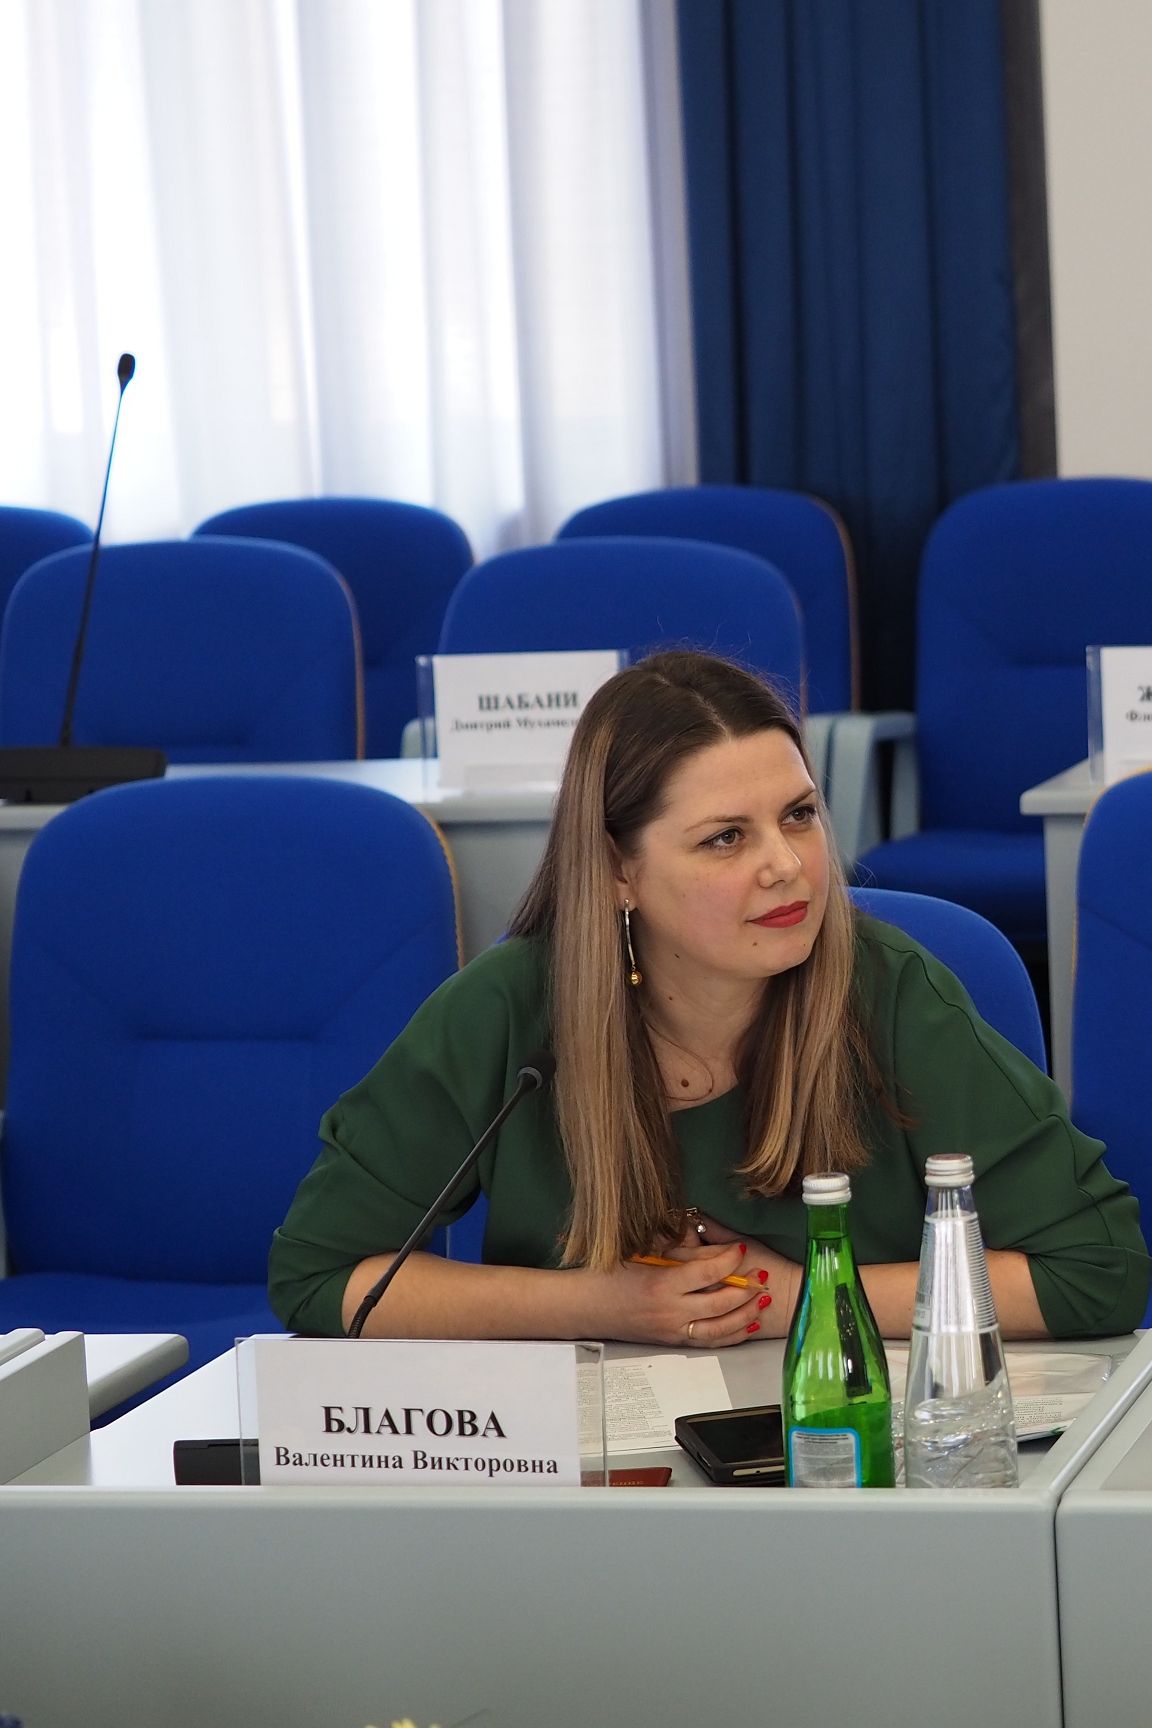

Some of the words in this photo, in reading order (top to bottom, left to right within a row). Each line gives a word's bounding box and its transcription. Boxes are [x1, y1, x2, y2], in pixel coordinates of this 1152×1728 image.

[478, 691, 579, 712] ШАБАНИ
[320, 1405, 508, 1440] БЛАГОВА
[274, 1446, 404, 1470] Валентина
[412, 1450, 559, 1478] Викторовна
